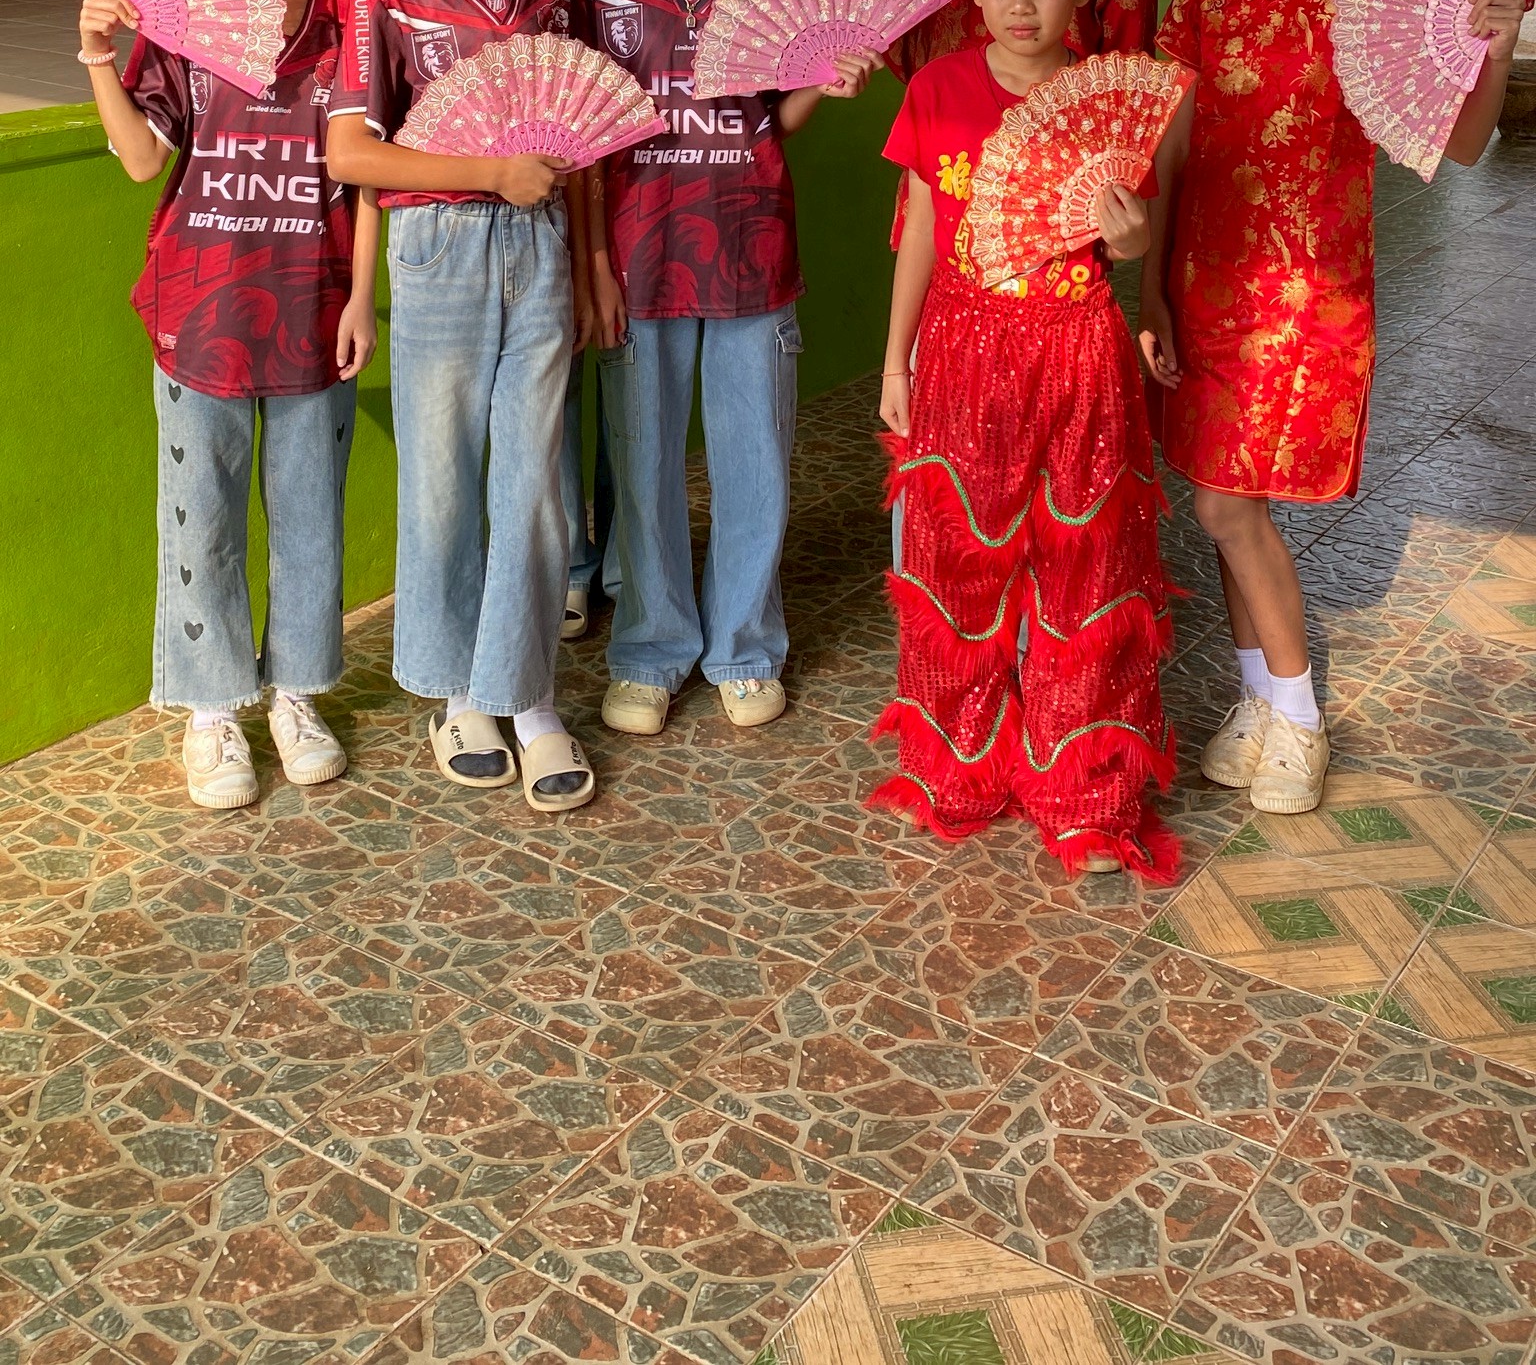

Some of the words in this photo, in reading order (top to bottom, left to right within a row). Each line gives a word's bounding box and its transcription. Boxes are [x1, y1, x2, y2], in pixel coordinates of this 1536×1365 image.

[270, 106, 292, 114] Edition
[193, 131, 327, 163] URTL
[202, 171, 320, 204] KING
[935, 150, 972, 202] 福
